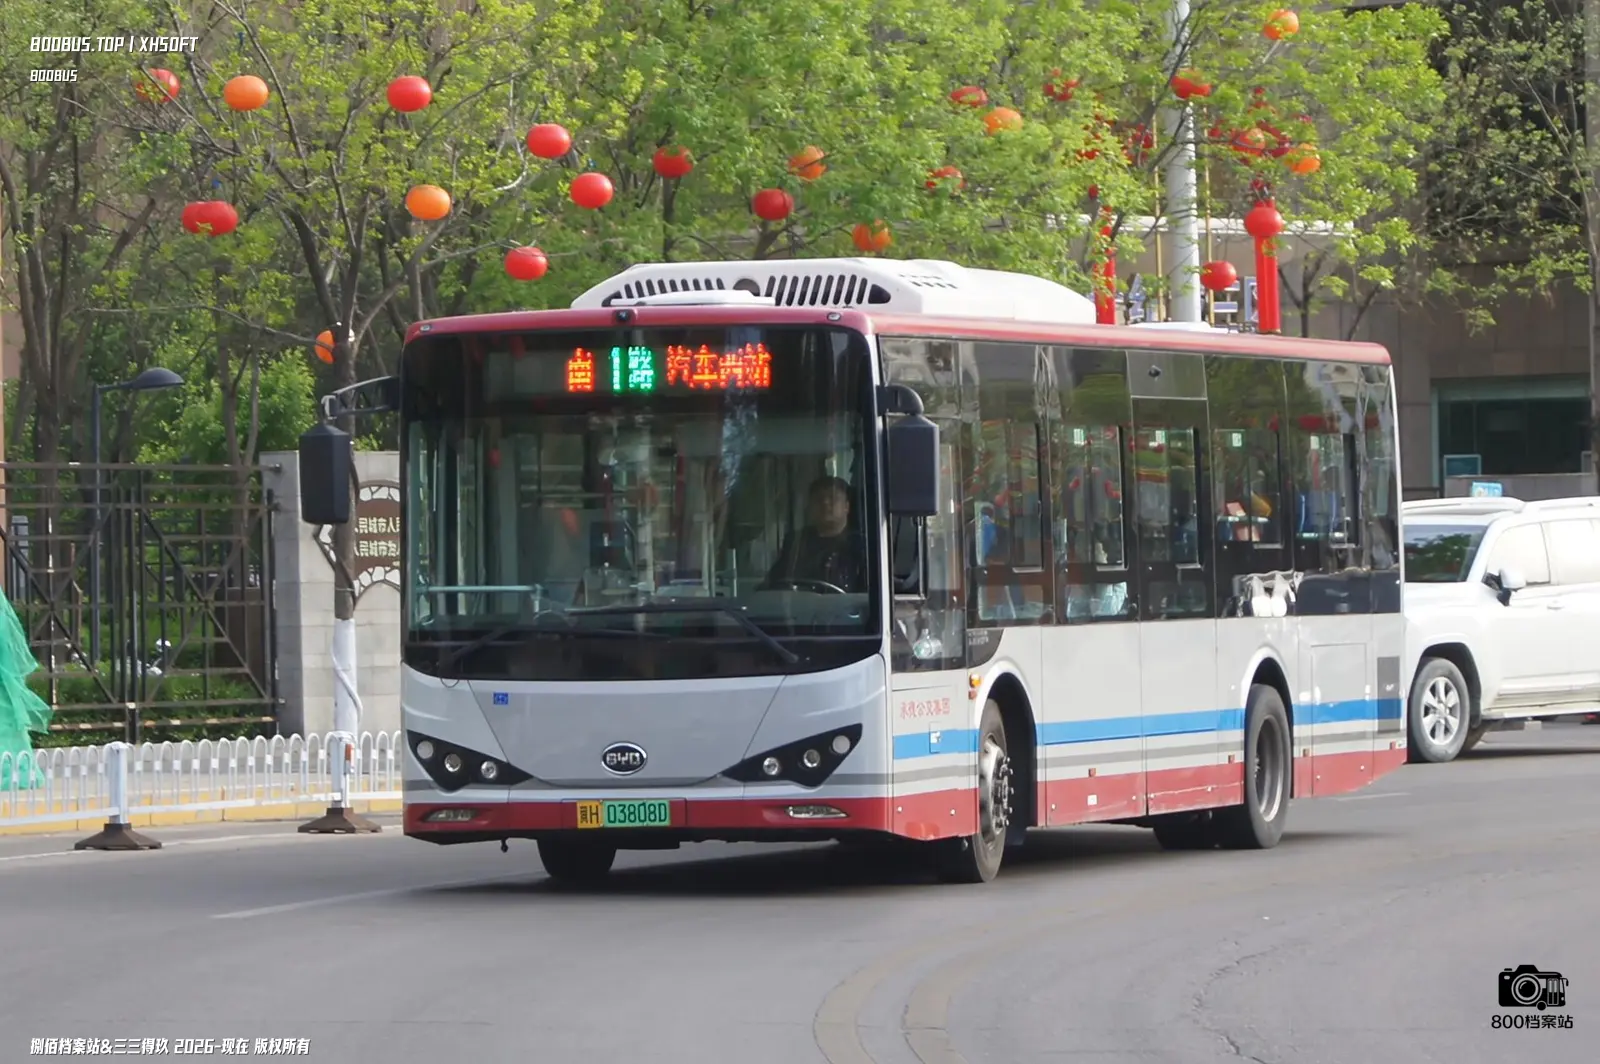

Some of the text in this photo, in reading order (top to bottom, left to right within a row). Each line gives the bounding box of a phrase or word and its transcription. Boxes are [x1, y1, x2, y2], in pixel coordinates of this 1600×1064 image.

[354, 517, 400, 533] 民城市人
[606, 752, 640, 766] BYD
